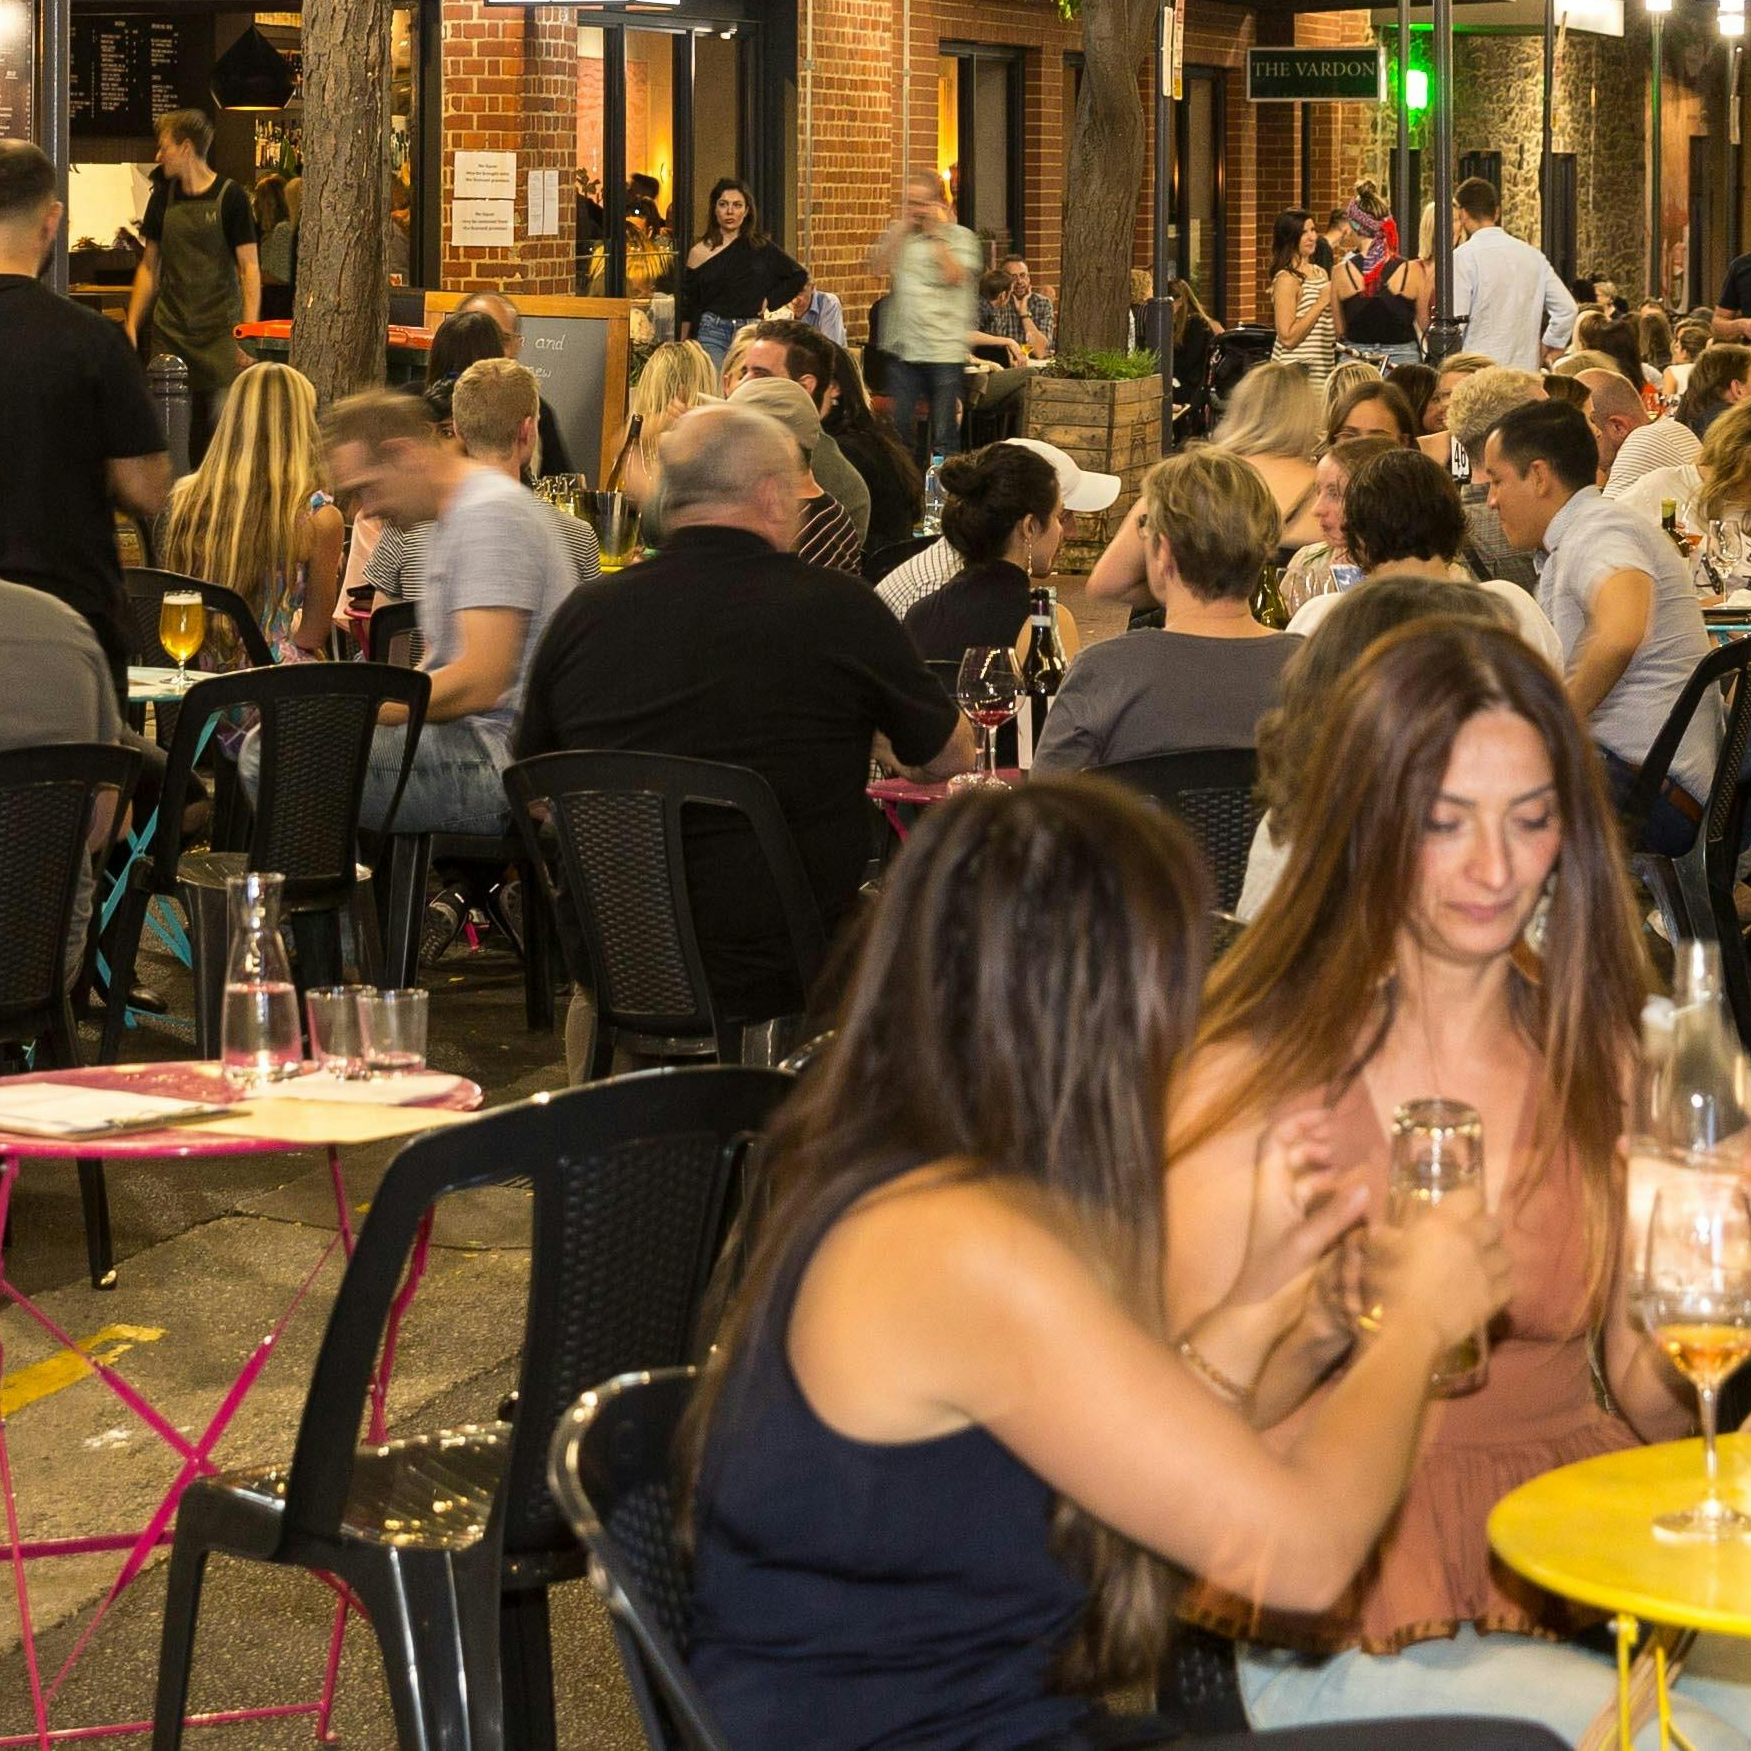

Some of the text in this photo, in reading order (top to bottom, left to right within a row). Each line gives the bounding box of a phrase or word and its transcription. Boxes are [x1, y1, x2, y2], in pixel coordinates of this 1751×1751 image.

[1252, 61, 1376, 77] THE VARDON
[534, 334, 567, 351] and
